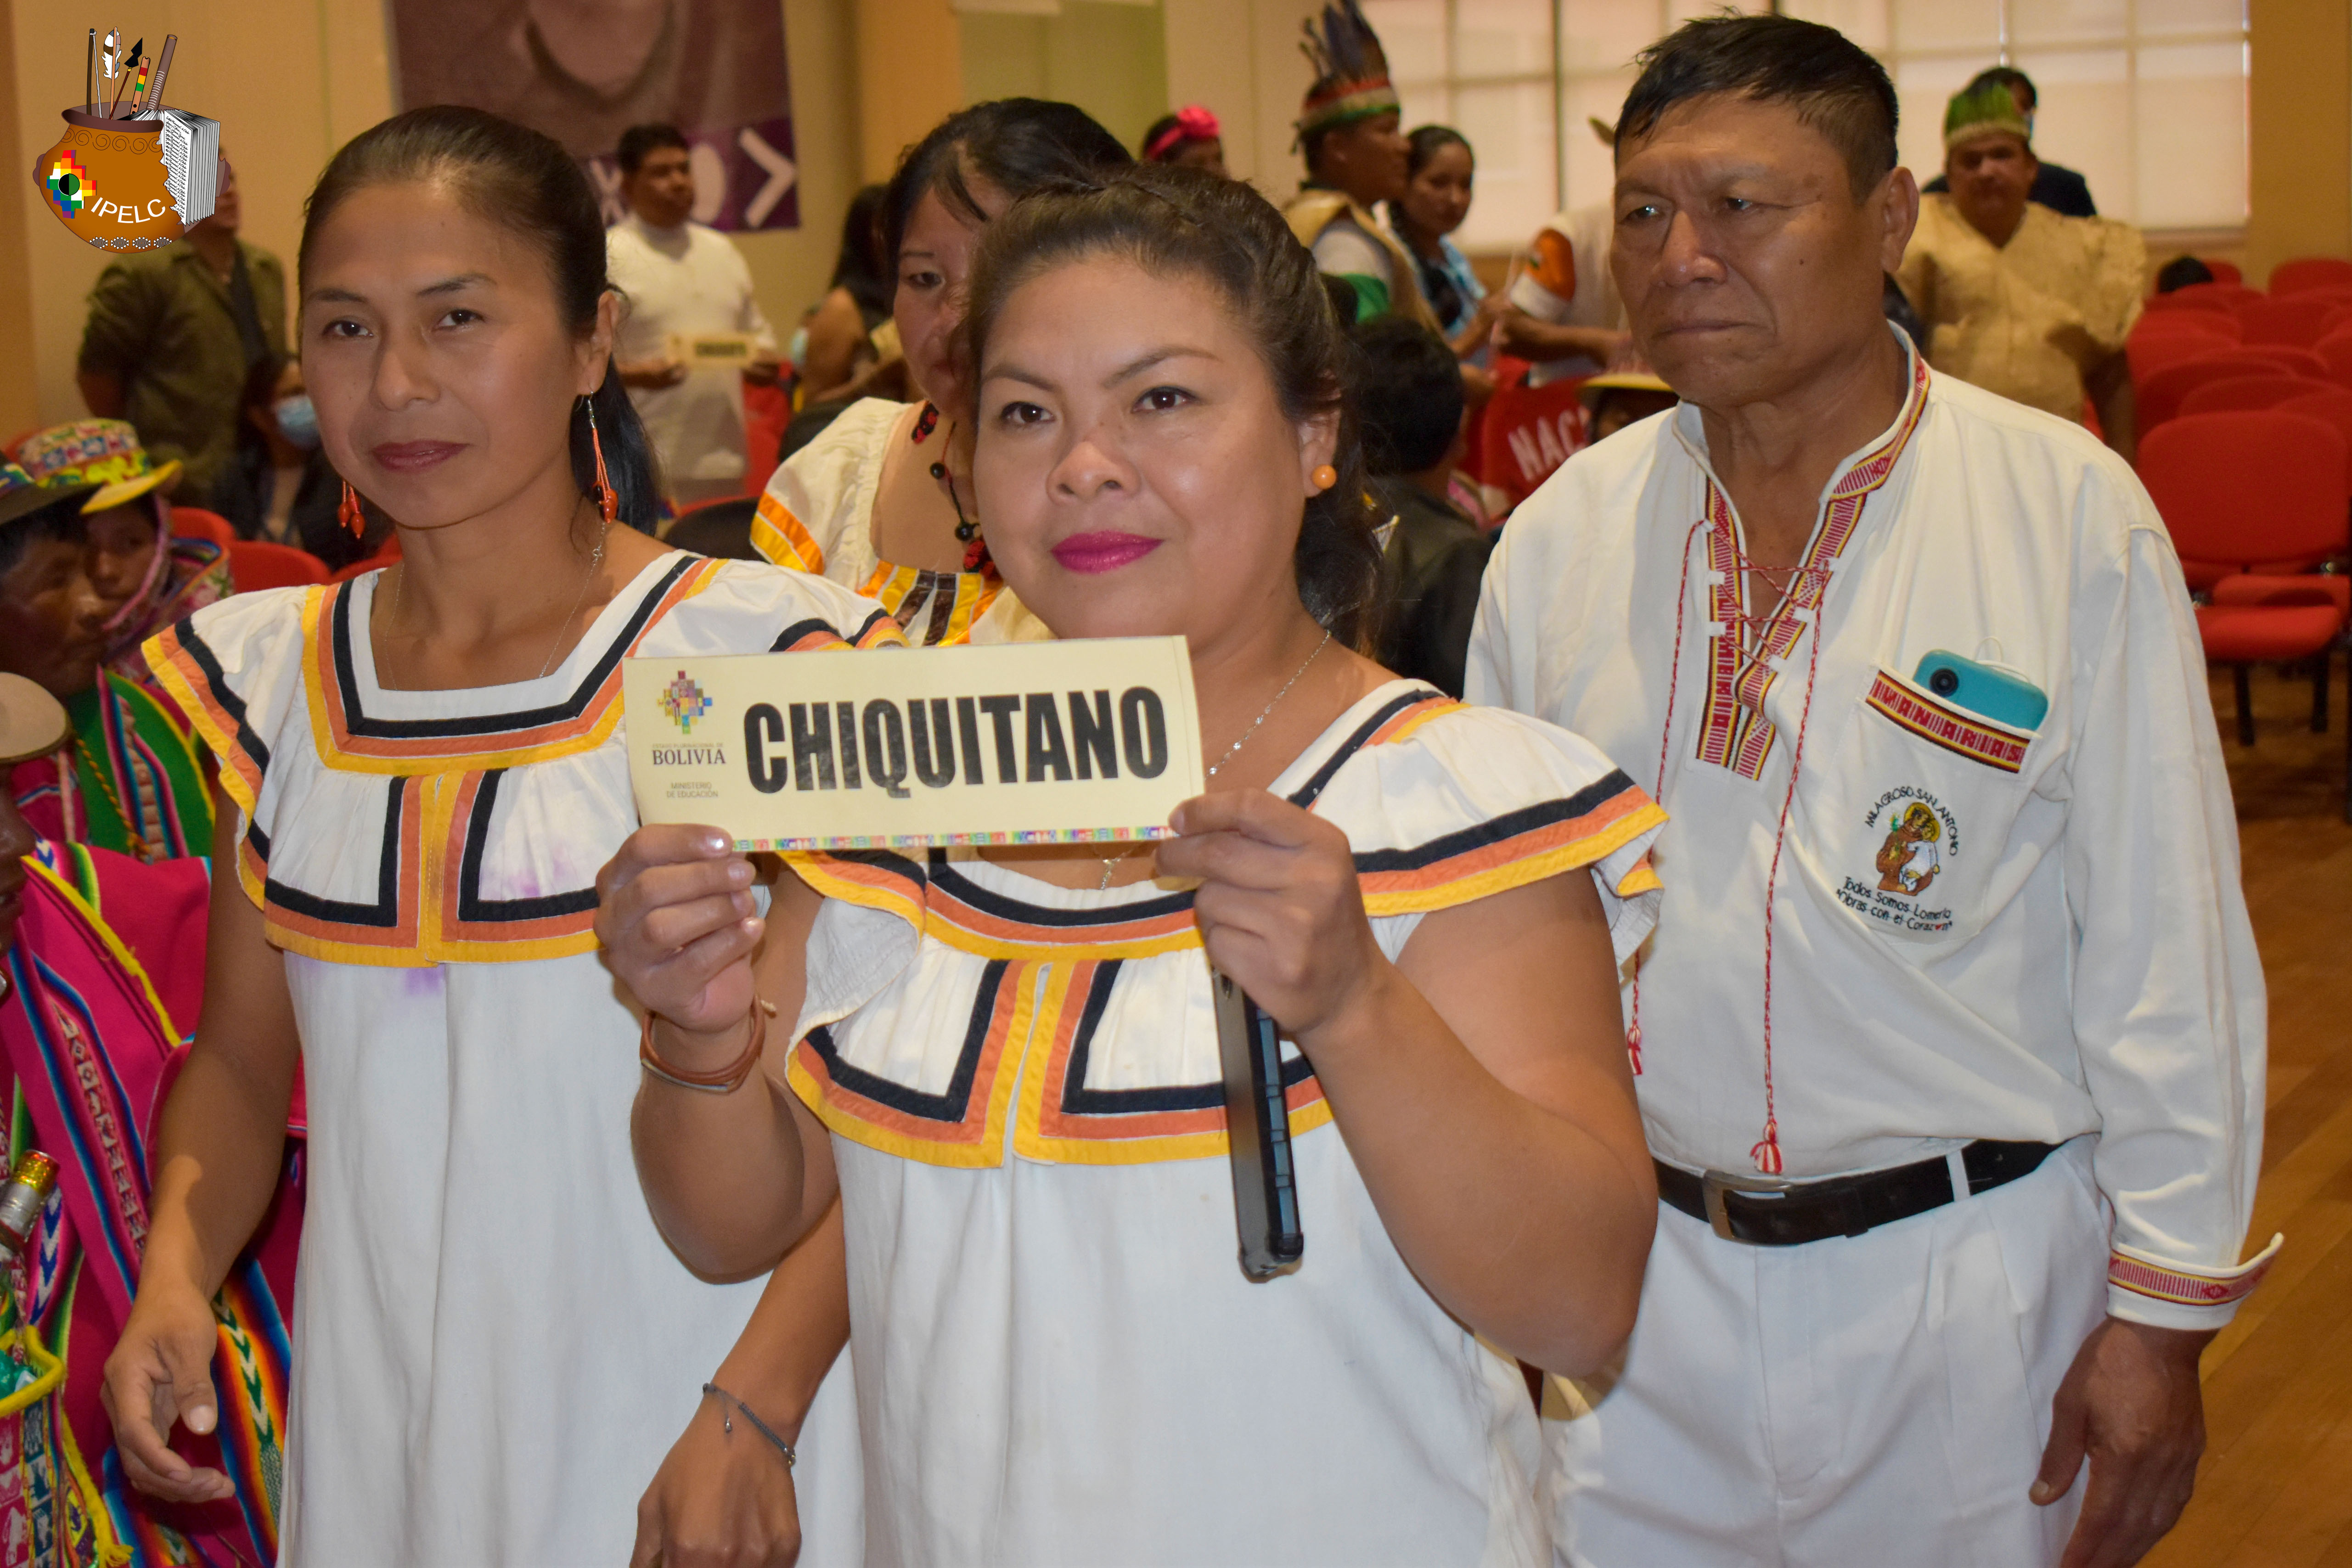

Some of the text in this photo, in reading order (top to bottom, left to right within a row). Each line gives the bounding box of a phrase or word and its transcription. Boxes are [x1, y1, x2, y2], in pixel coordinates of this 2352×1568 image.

[652, 749, 726, 765] BOLIVIA
[744, 686, 1168, 798] CHIQUITANO
[1939, 719, 2024, 764] ARIAS
[1864, 786, 1958, 856] MILAGROSO SAN ANTONIO
[1843, 876, 1871, 898] Todos
[1875, 892, 1909, 912] Somos
[1870, 906, 1889, 921] con
[1893, 914, 1904, 925] el
